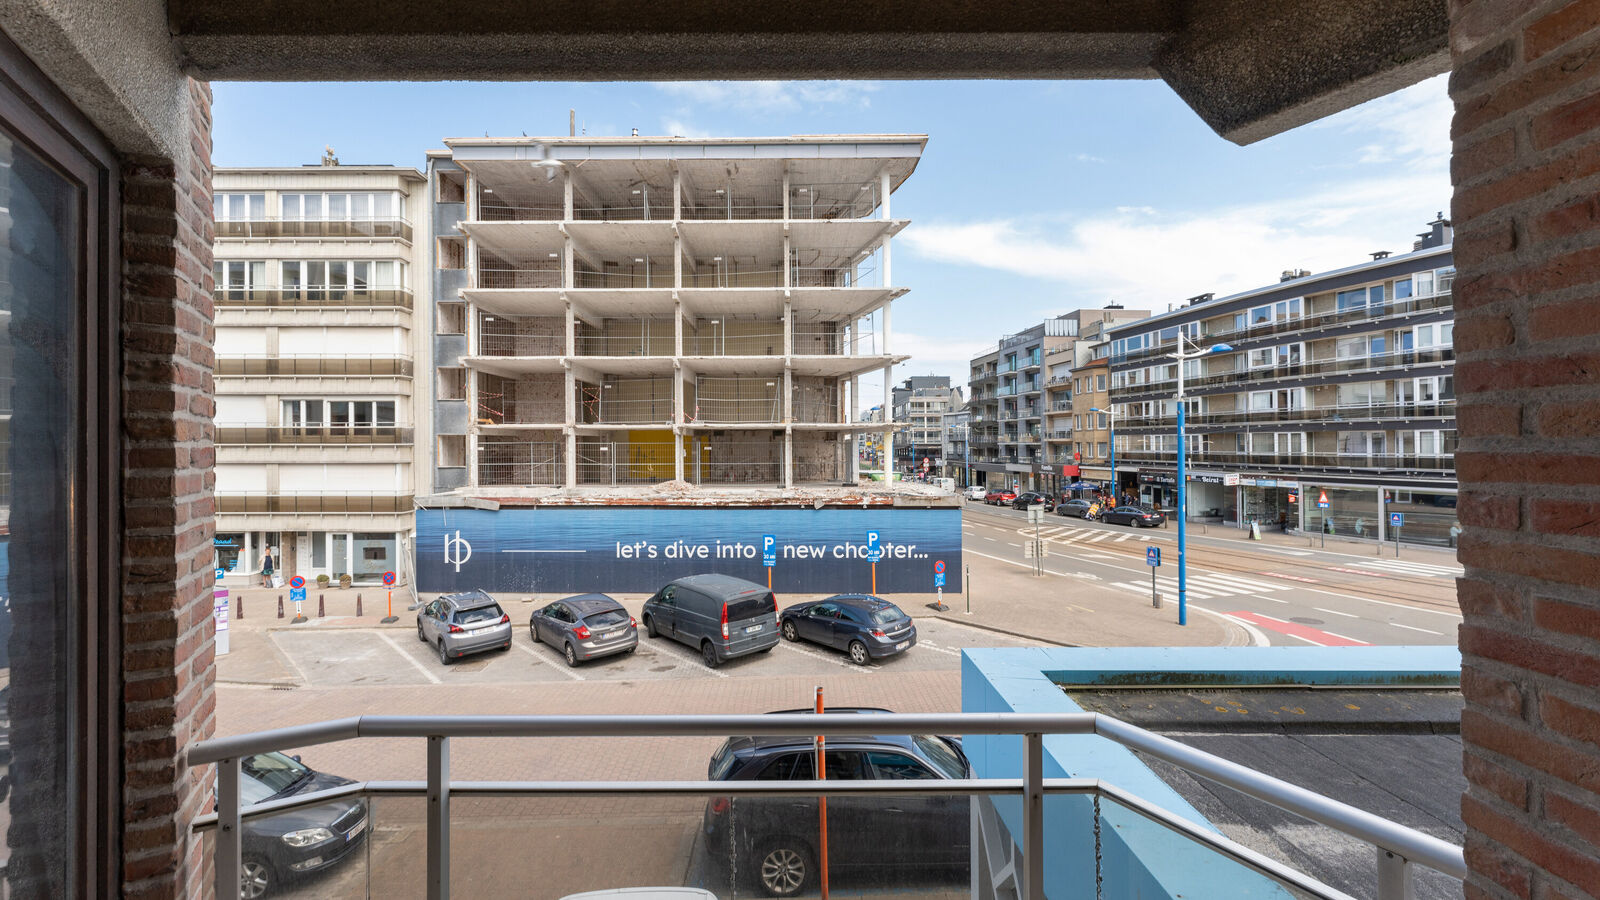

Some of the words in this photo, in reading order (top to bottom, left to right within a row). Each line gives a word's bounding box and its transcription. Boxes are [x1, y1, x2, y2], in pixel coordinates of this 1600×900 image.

[764, 537, 774, 550] P
[869, 532, 878, 546] P
[616, 541, 658, 558] let's
[664, 540, 709, 558] dive
[716, 540, 757, 558] into
[783, 544, 827, 558] new
[215, 570, 223, 578] P
